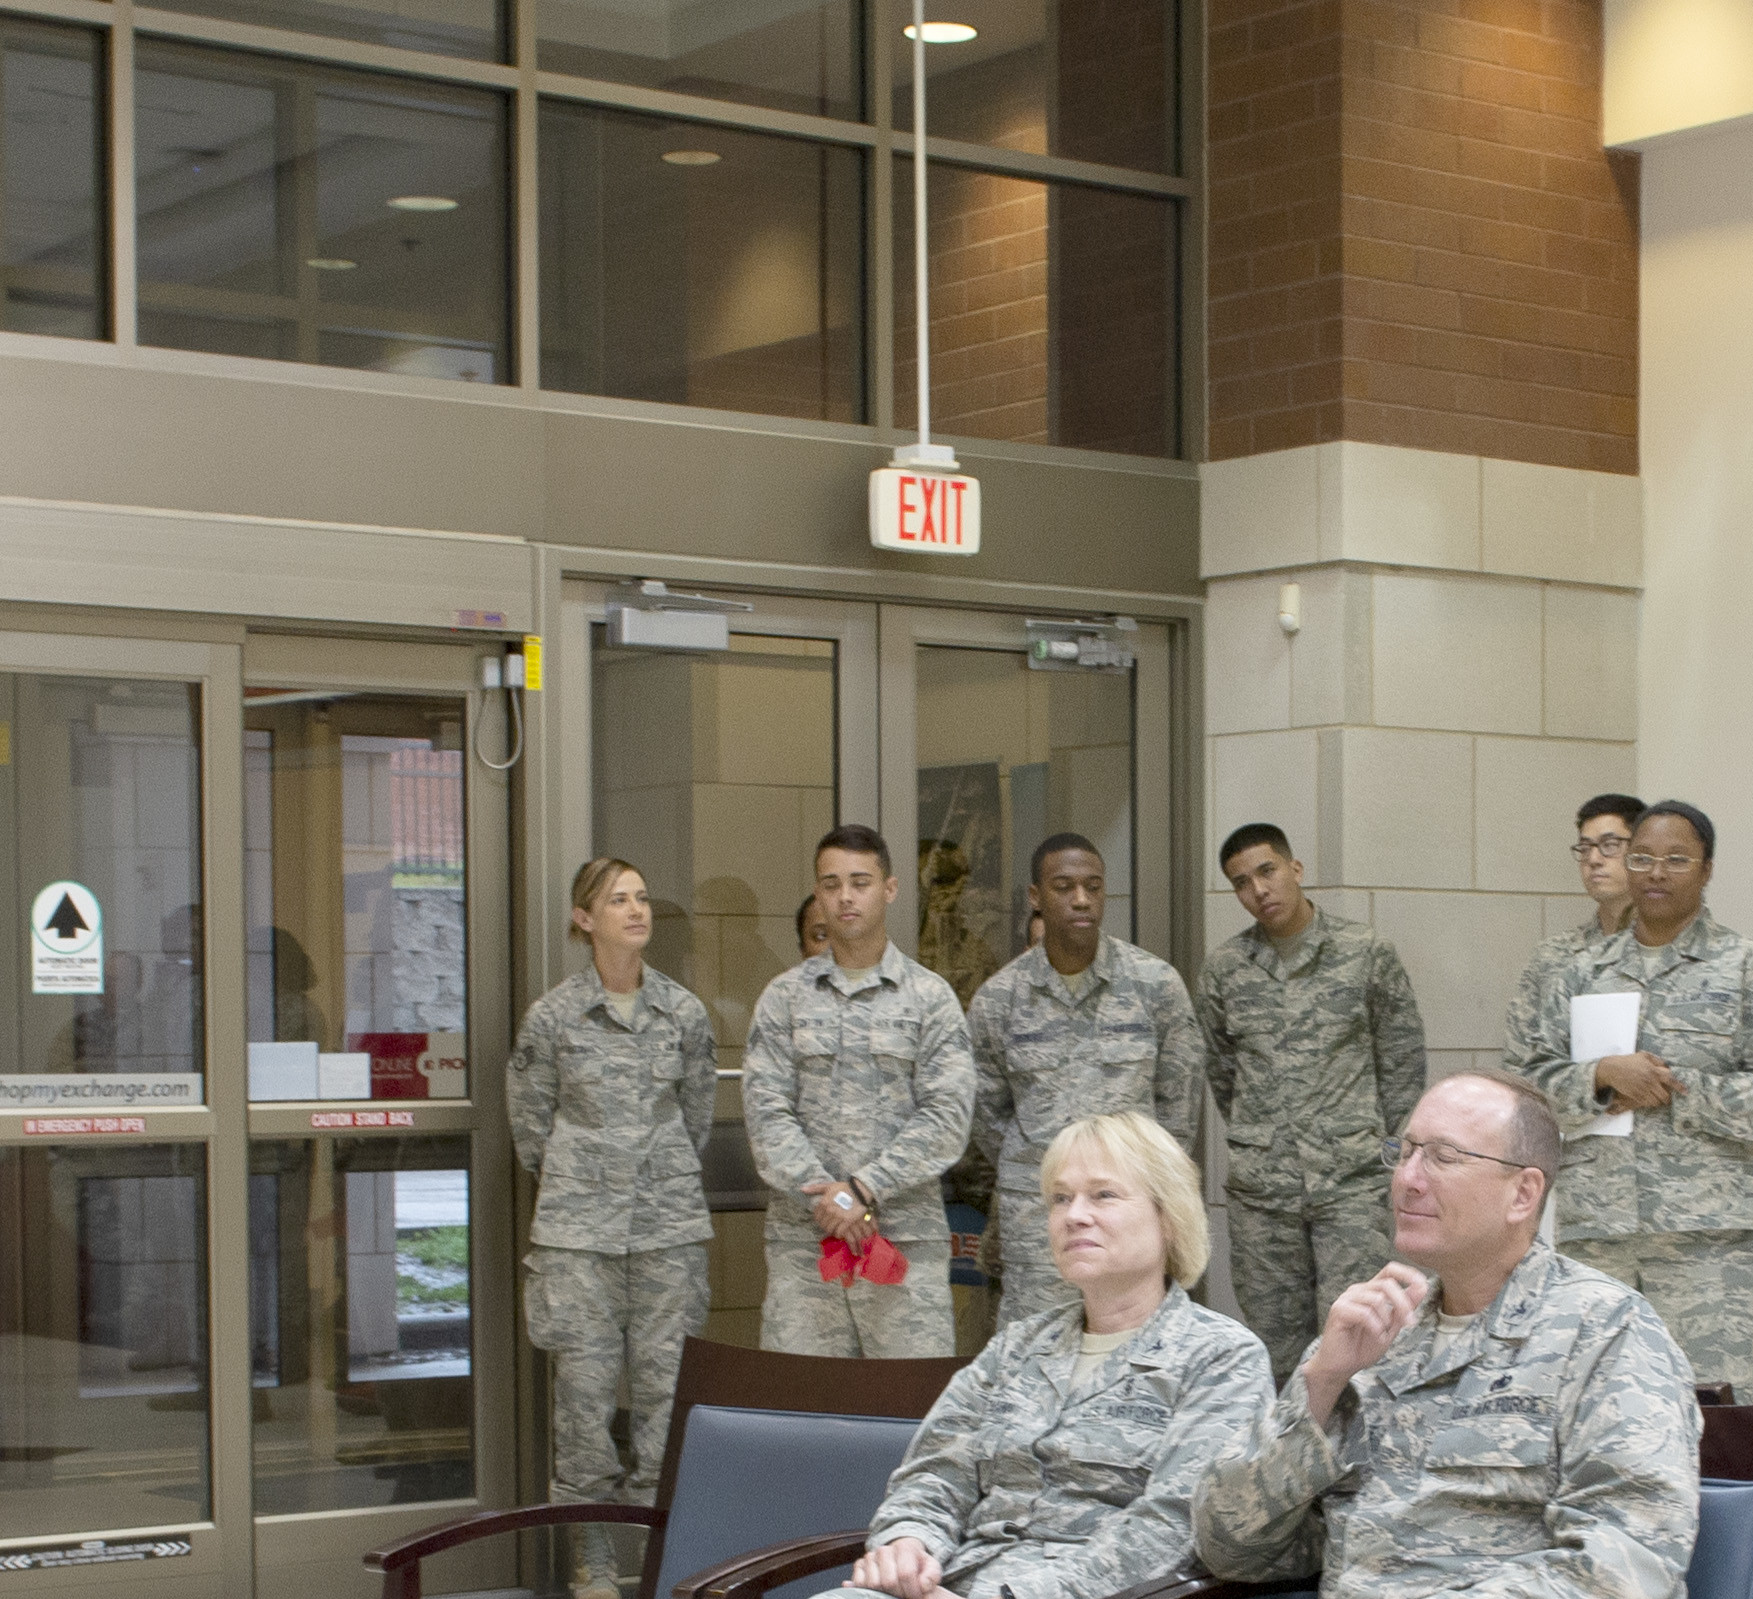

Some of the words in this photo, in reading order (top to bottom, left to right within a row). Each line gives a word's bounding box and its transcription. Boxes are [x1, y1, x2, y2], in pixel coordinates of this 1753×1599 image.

[899, 476, 967, 545] EXIT
[38, 1119, 92, 1133] EMERGENCY
[94, 1118, 119, 1132] PUSH
[120, 1117, 145, 1132] OPEN
[312, 1114, 352, 1127] CAUTION
[355, 1113, 386, 1126] STAND
[388, 1112, 414, 1125] BACK
